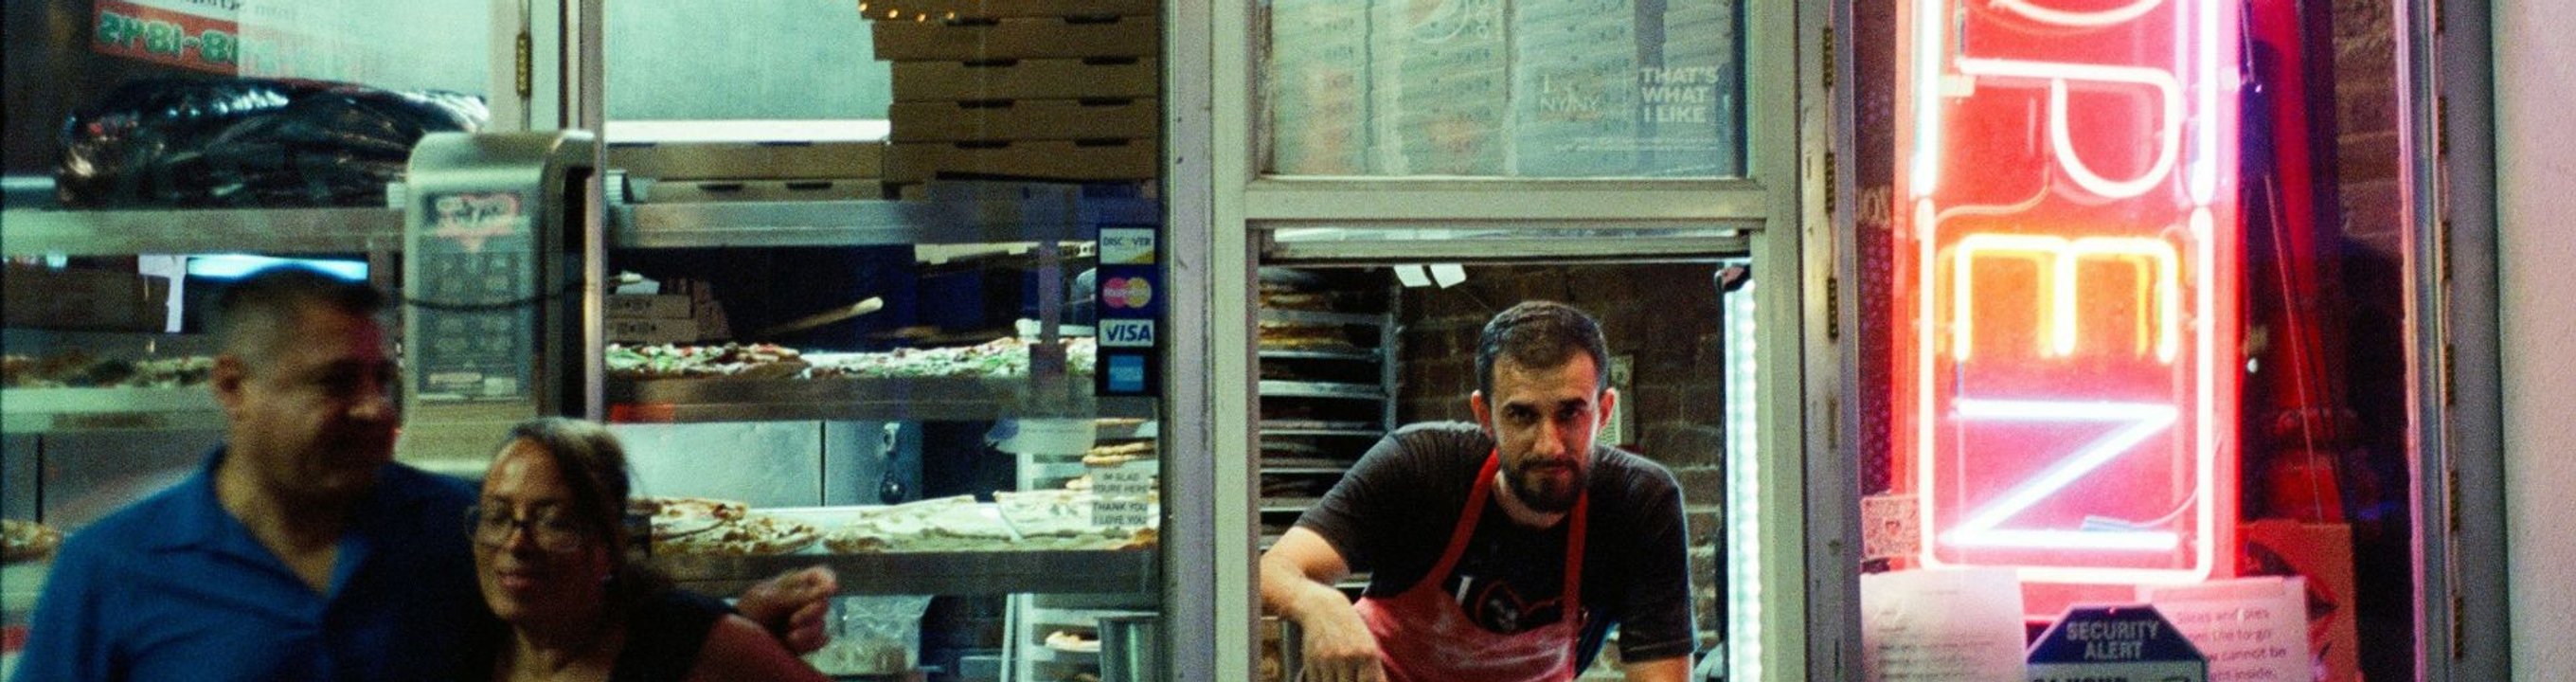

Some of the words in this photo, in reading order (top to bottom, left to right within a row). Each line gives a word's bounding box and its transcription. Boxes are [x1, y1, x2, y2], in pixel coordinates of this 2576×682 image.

[1641, 65, 1719, 84] THAT'S
[1641, 85, 1709, 103] WHAT
[1644, 107, 1650, 122] I
[1656, 106, 1707, 123] LIKE
[1941, 0, 2183, 552] PEN
[1107, 325, 1153, 342] VISA
[1093, 501, 1125, 511] THANK
[1128, 501, 1148, 511] YOU
[2066, 620, 2159, 641] SECURITY
[2084, 641, 2142, 660] ALERT
[2269, 647, 2287, 658] be
